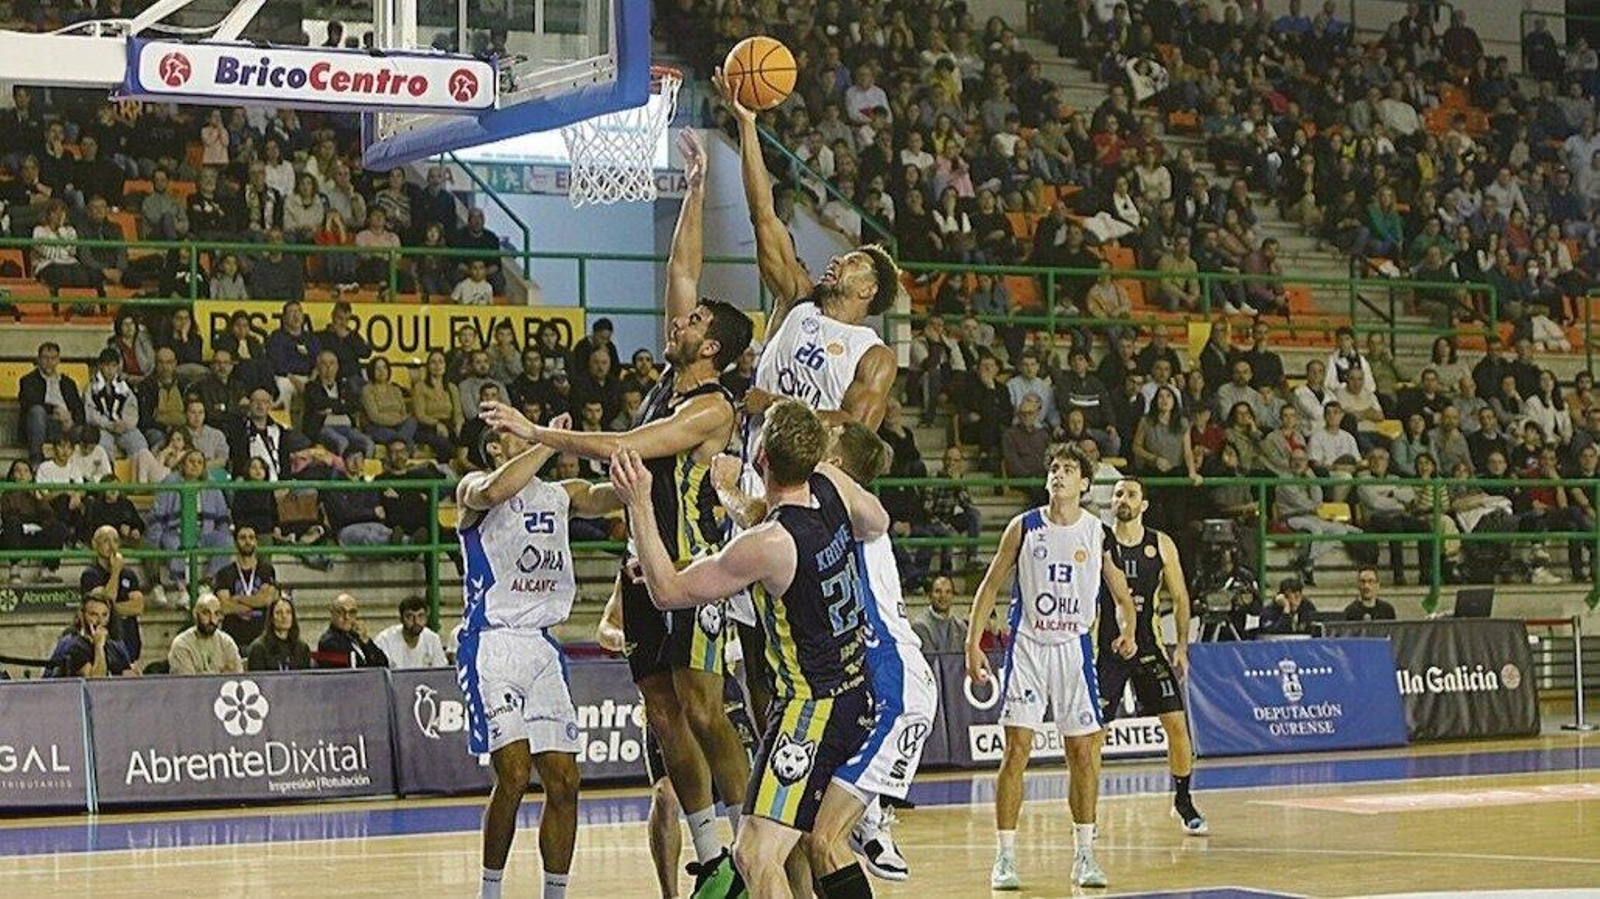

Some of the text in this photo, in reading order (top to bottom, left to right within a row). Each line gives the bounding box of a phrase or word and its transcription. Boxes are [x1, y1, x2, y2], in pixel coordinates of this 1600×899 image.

[215, 55, 428, 96] BricoCentro
[795, 342, 824, 371] 26
[523, 511, 555, 534] 25
[1048, 563, 1073, 583] 13
[510, 579, 558, 592] ALICANTE
[1035, 593, 1080, 616] OHLA
[1034, 620, 1079, 632] ALICANTE
[1426, 664, 1499, 694] Galicia
[1253, 700, 1343, 722] DEPUTACIÓN
[1268, 720, 1336, 737] OURENSE
[125, 734, 368, 786] AbrenteDixital
